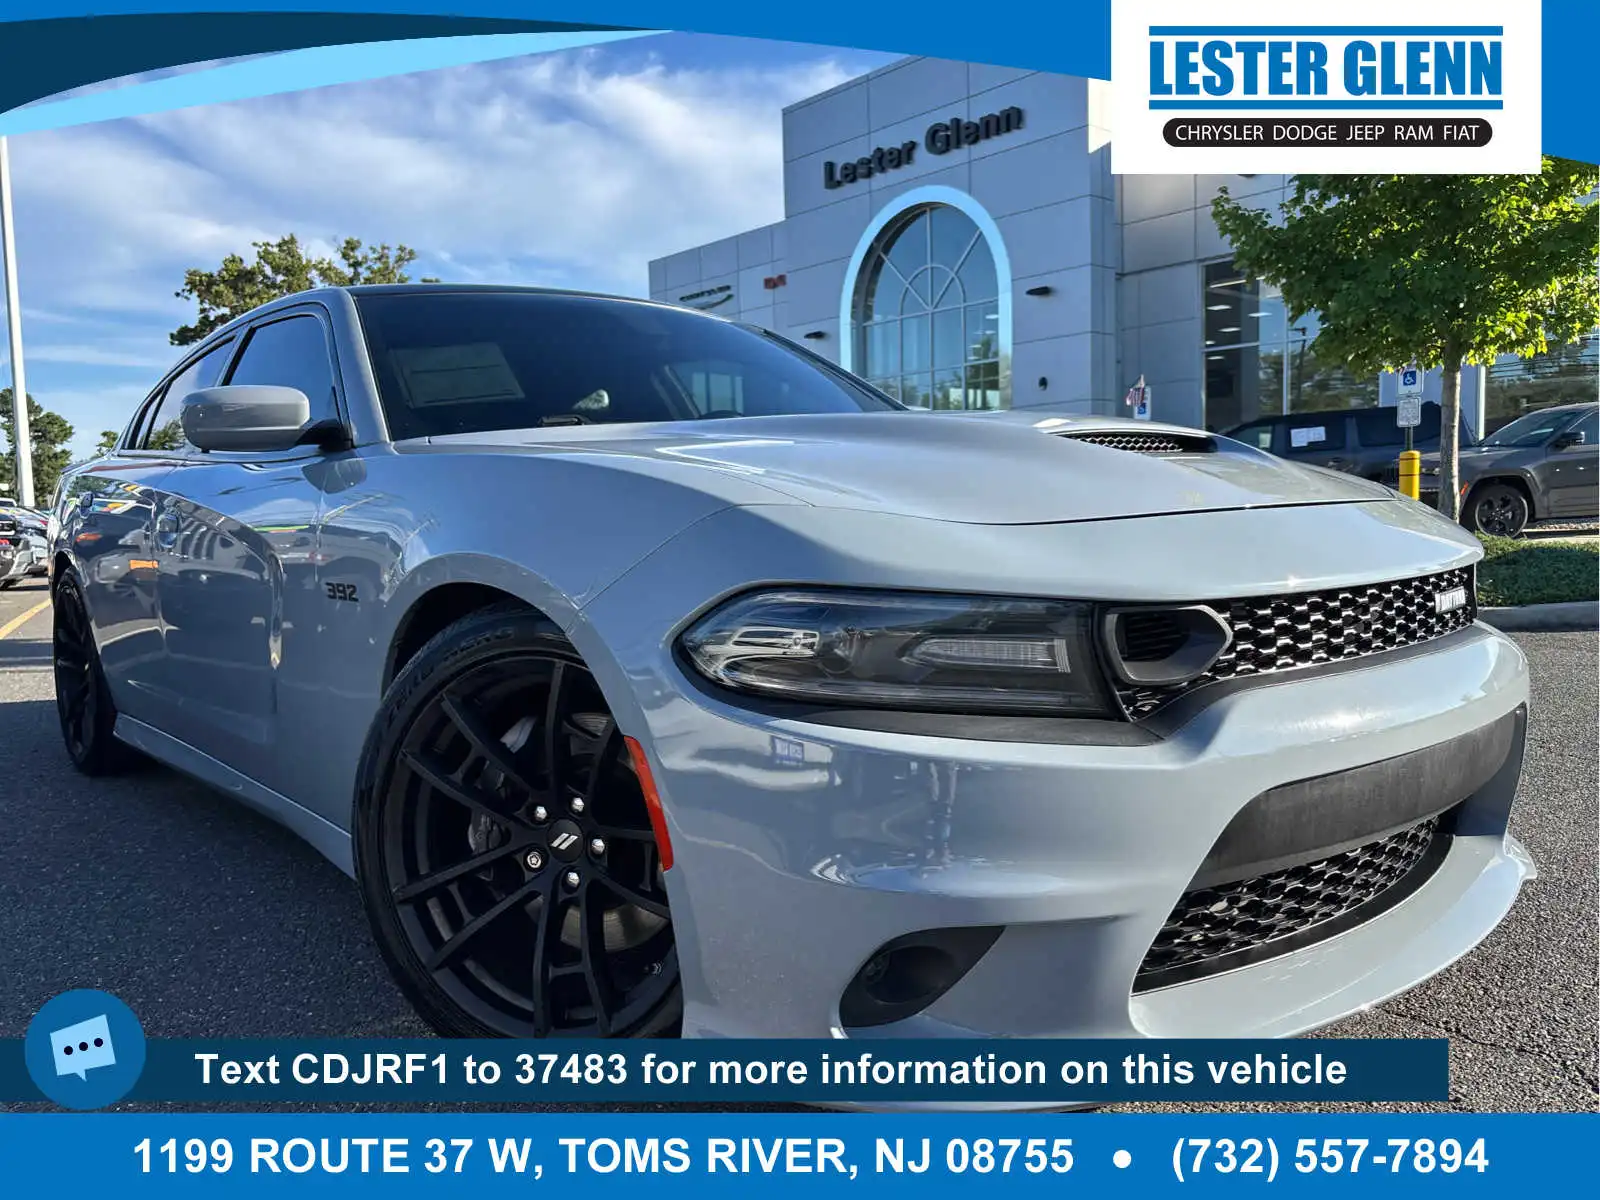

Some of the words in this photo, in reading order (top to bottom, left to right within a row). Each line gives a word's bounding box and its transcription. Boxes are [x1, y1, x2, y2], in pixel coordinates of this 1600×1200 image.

[824, 140, 917, 189] Lester
[925, 105, 1024, 155] Glenn
[325, 582, 359, 602] 392
